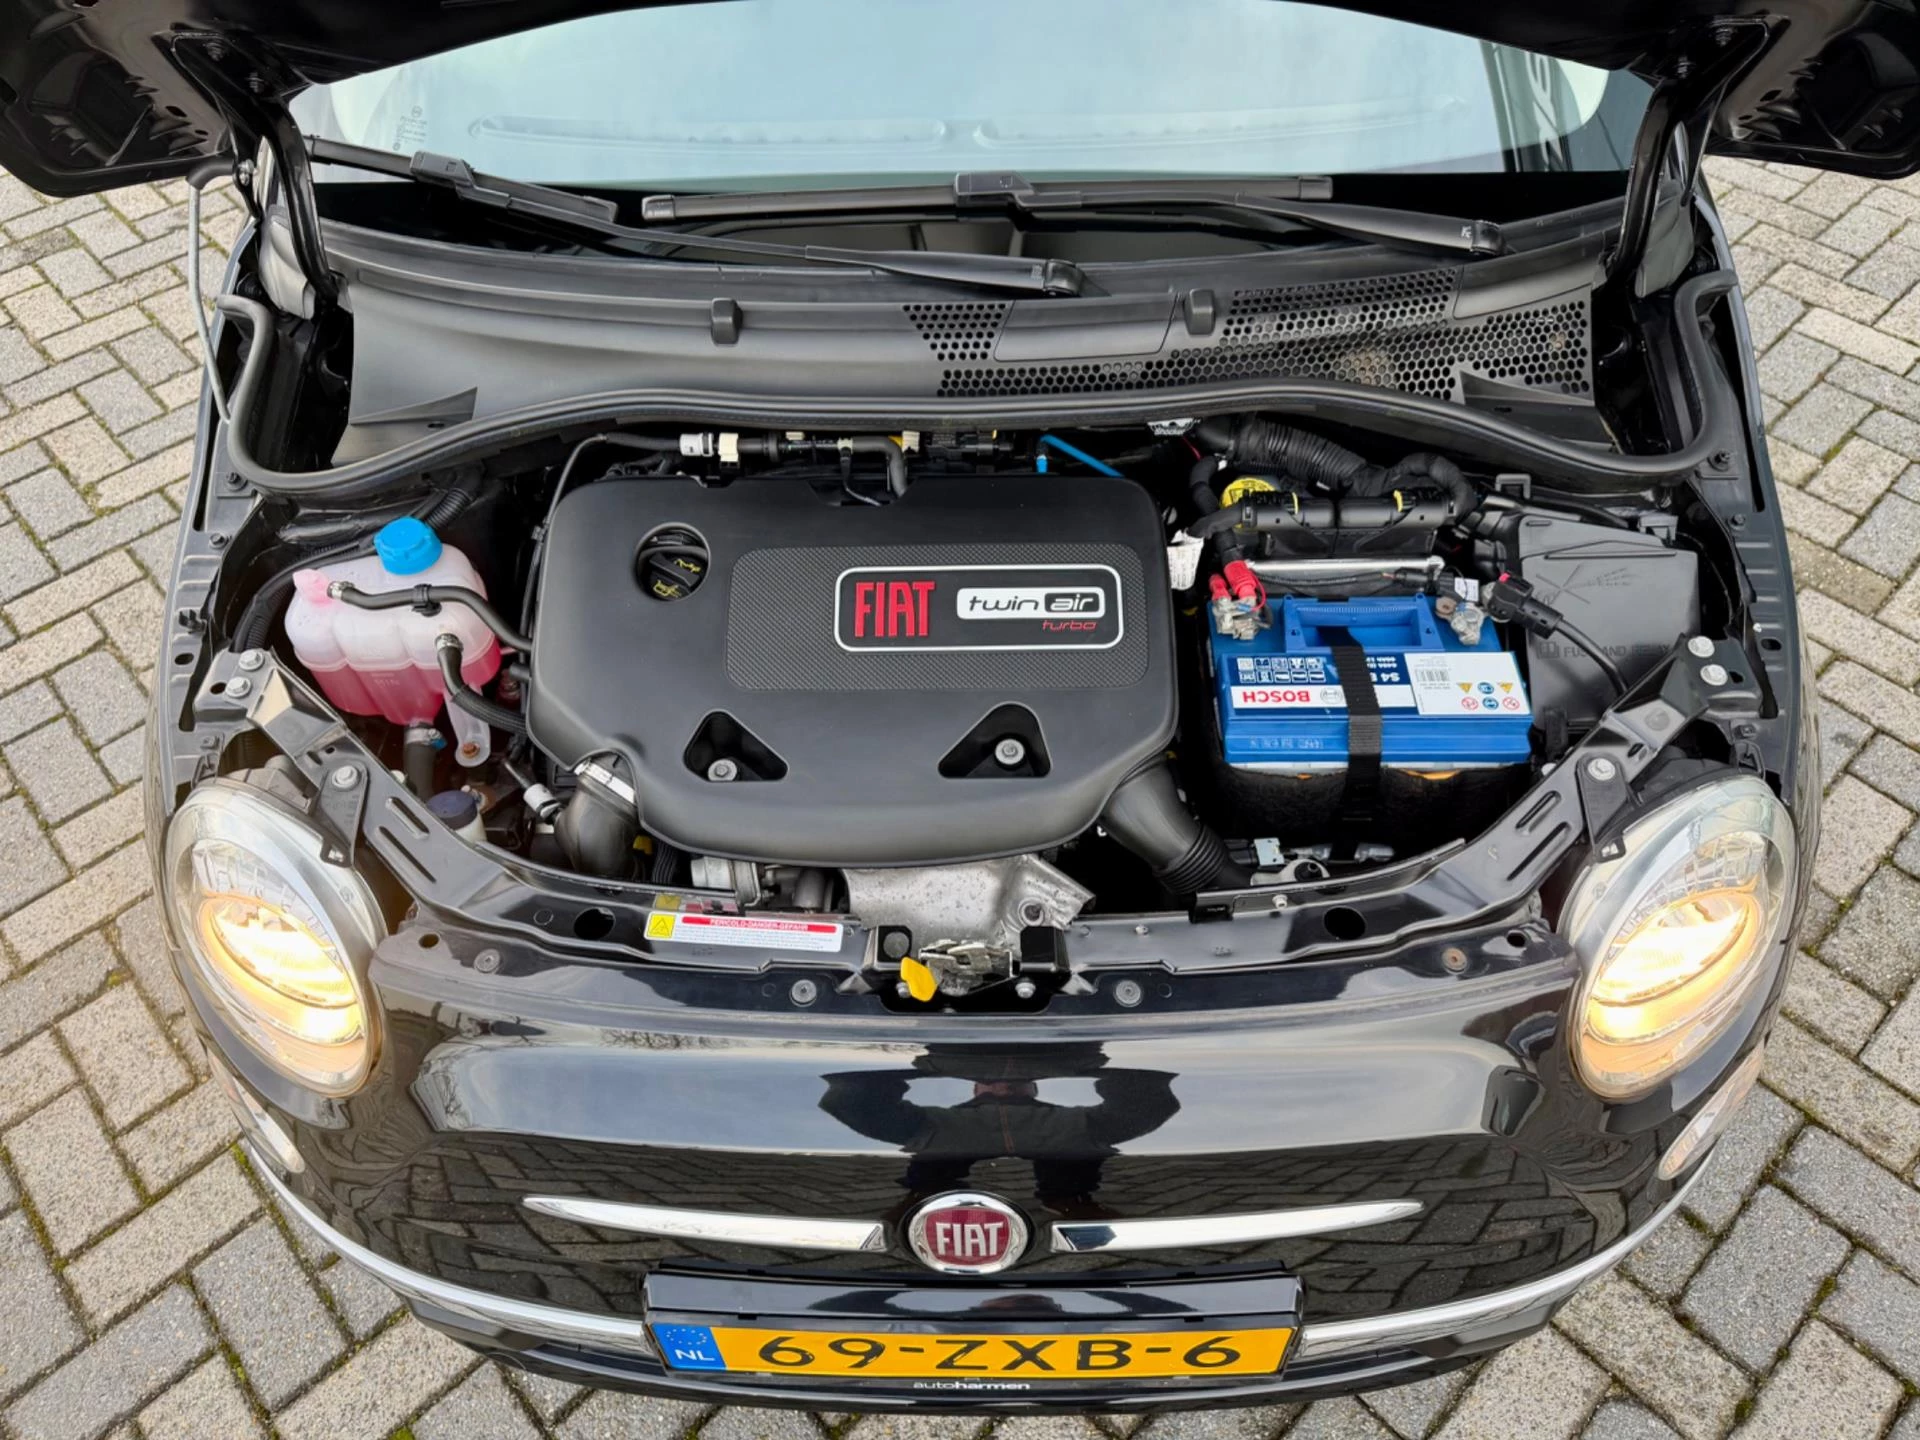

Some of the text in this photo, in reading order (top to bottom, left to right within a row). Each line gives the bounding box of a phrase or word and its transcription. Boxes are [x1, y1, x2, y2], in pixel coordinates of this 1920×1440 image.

[855, 581, 935, 637] FIAT
[1042, 619, 1097, 631] turbo
[1242, 690, 1311, 703] BOSCH
[935, 1221, 1004, 1257] FIAT
[675, 1348, 715, 1362] NL
[758, 1335, 1241, 1371] 69-ZXB-6
[912, 1380, 1031, 1391] autoharmen
